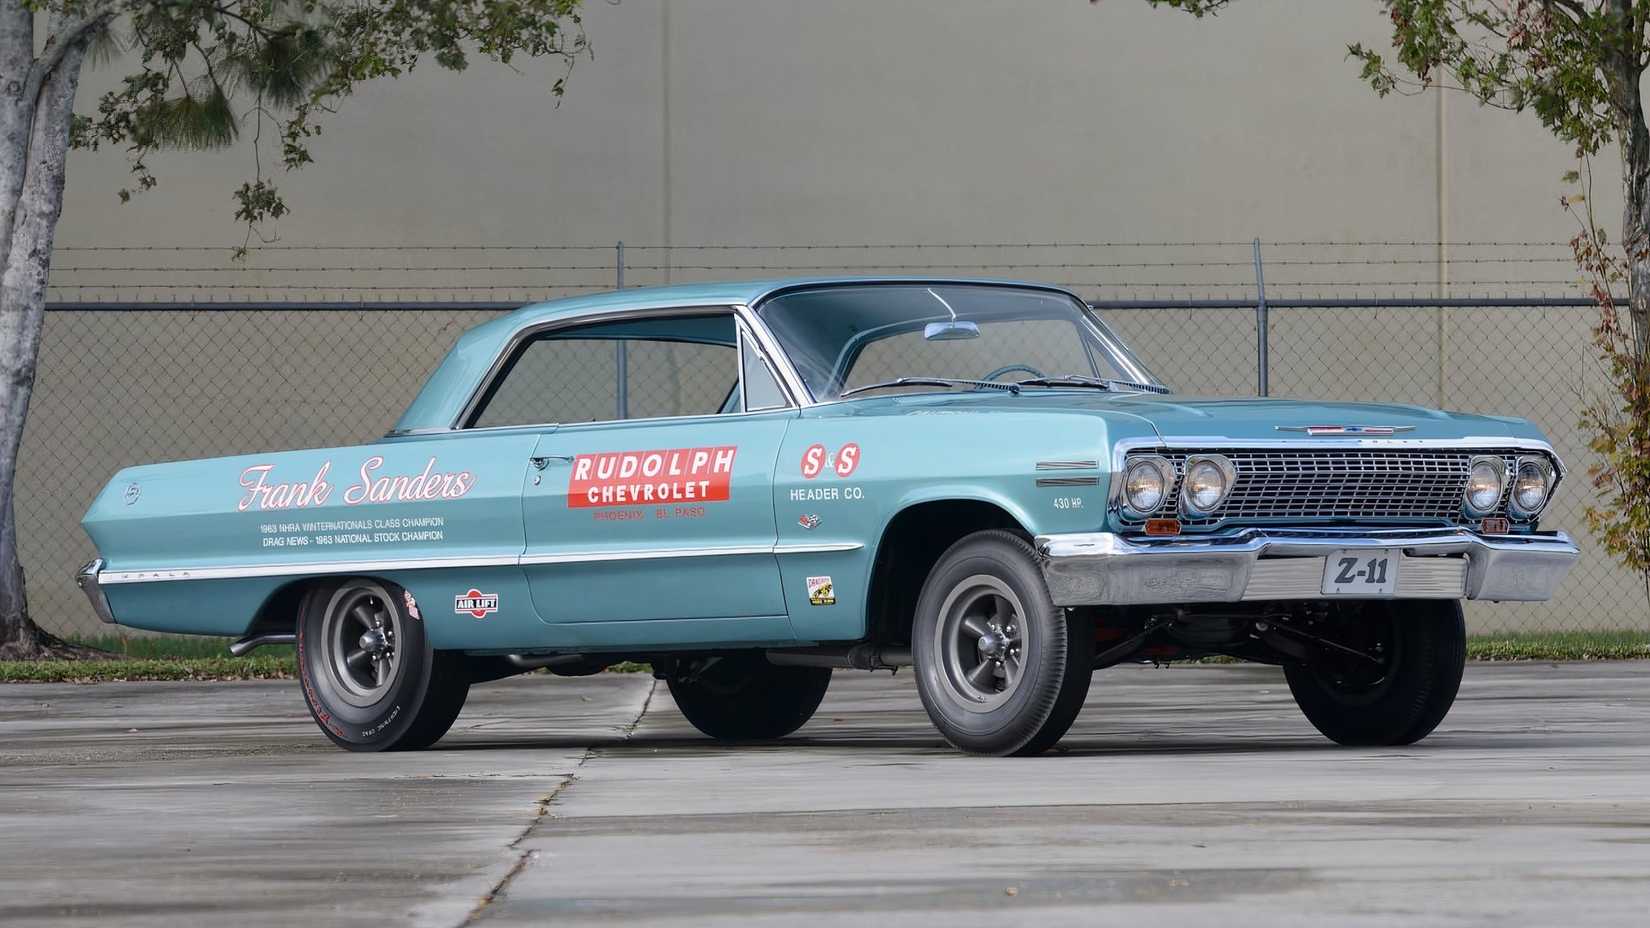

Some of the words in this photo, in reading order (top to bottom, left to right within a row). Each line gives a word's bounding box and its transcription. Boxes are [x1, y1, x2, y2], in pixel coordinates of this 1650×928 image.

[575, 449, 734, 481] RUDOLPH
[237, 460, 335, 512] Frank
[344, 456, 477, 504] Sanders
[587, 480, 710, 503] CHEVROLET
[790, 487, 839, 501] HEADER
[844, 486, 865, 499] CO.
[1053, 497, 1070, 509] 430
[675, 506, 705, 518] PASO
[260, 524, 277, 534] 1963
[279, 522, 300, 533] NHRA
[302, 519, 372, 532] WINTERNATIONALS
[374, 518, 400, 529] CLASS
[402, 516, 444, 528] CHAMPION
[263, 536, 284, 547] DRAG
[286, 535, 309, 547] NEWS
[316, 534, 333, 545] 1963
[334, 533, 372, 544] NATIONAL
[374, 531, 400, 543] STOCK
[401, 530, 443, 541] CHAMPION
[1334, 557, 1388, 584] Z-11
[457, 600, 474, 609] AIR
[475, 599, 496, 608] LIFT
